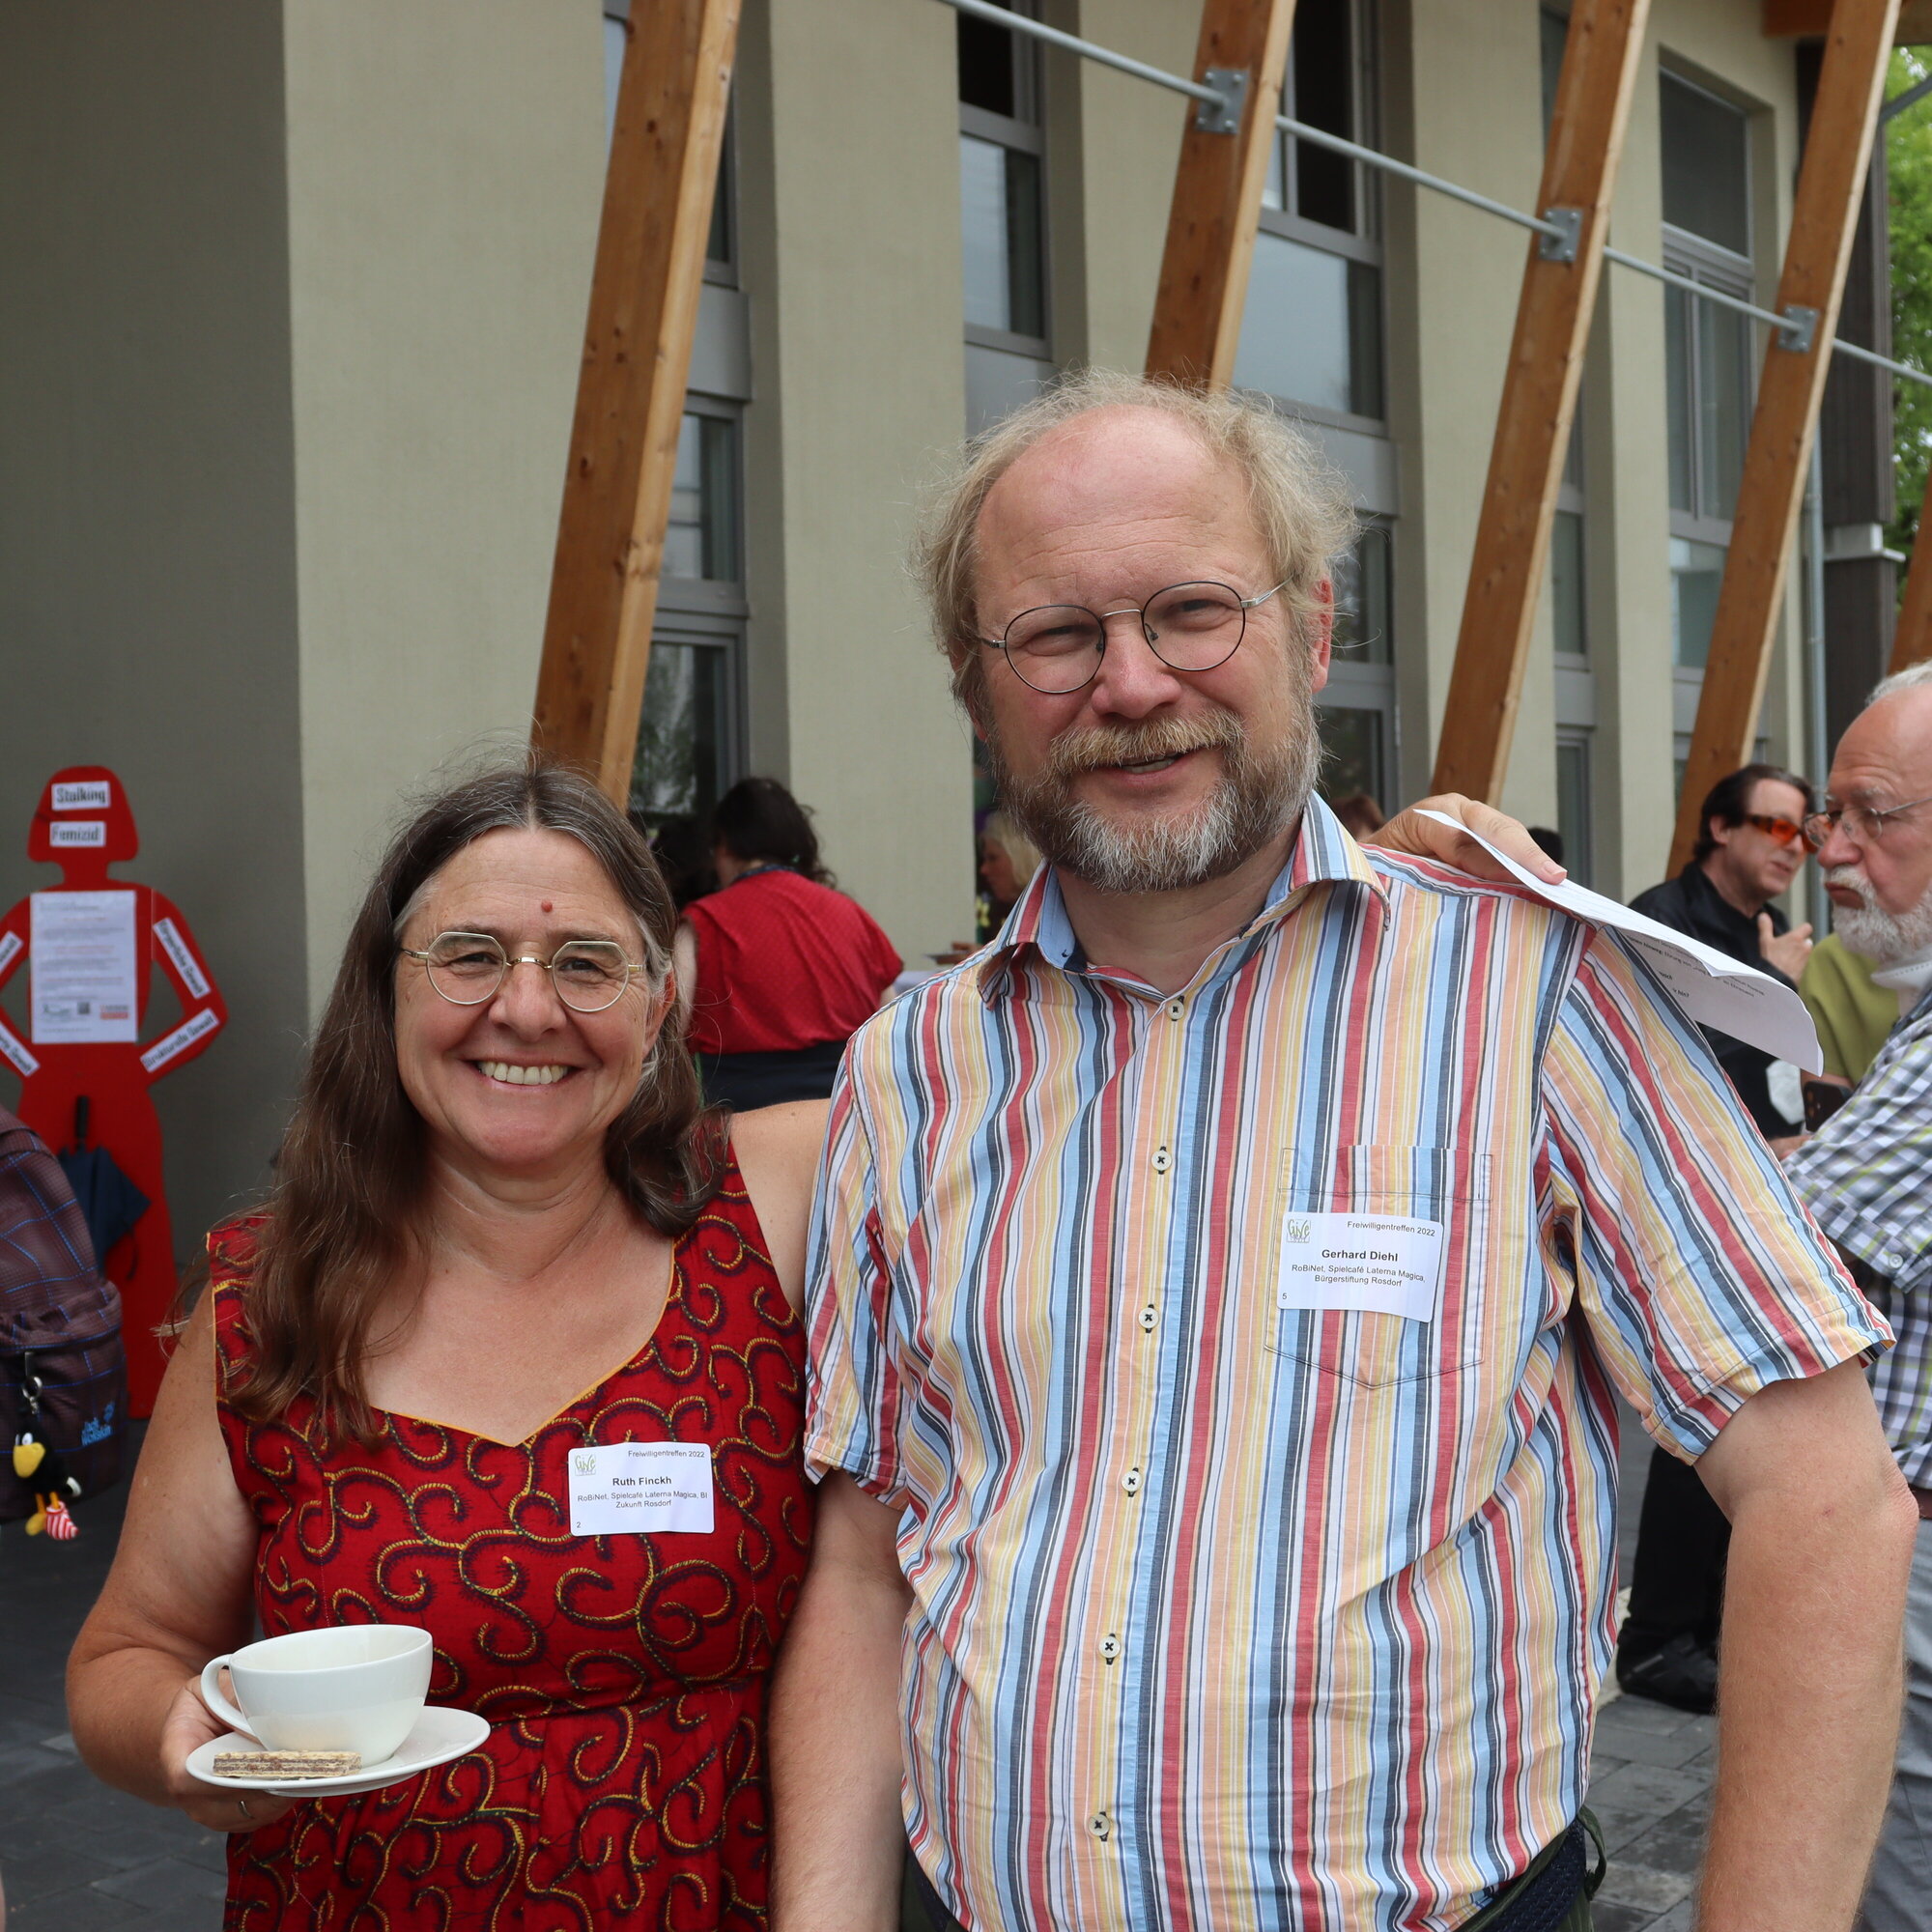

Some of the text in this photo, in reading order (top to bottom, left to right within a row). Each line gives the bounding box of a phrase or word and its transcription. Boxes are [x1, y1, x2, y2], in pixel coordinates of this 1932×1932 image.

[56, 785, 106, 804] Stalking
[52, 824, 99, 841] Femizid
[1347, 1220, 1435, 1236] Freiwilligentreffen 2022
[1321, 1249, 1398, 1262] Gerhard Diehl
[1292, 1264, 1426, 1283] RoBiNet, Spielcafé Laterna Magica,
[1315, 1274, 1403, 1287] Bürgerstiftung Rosdorf
[628, 1450, 687, 1459] Freiwilligentreffen
[612, 1476, 672, 1487] Ruth Finckh
[611, 1492, 643, 1500] Spielcafé
[645, 1491, 672, 1499] Laterna
[673, 1491, 699, 1499] Magica,
[615, 1500, 642, 1509] Zukunft
[576, 1520, 582, 1529] 2
